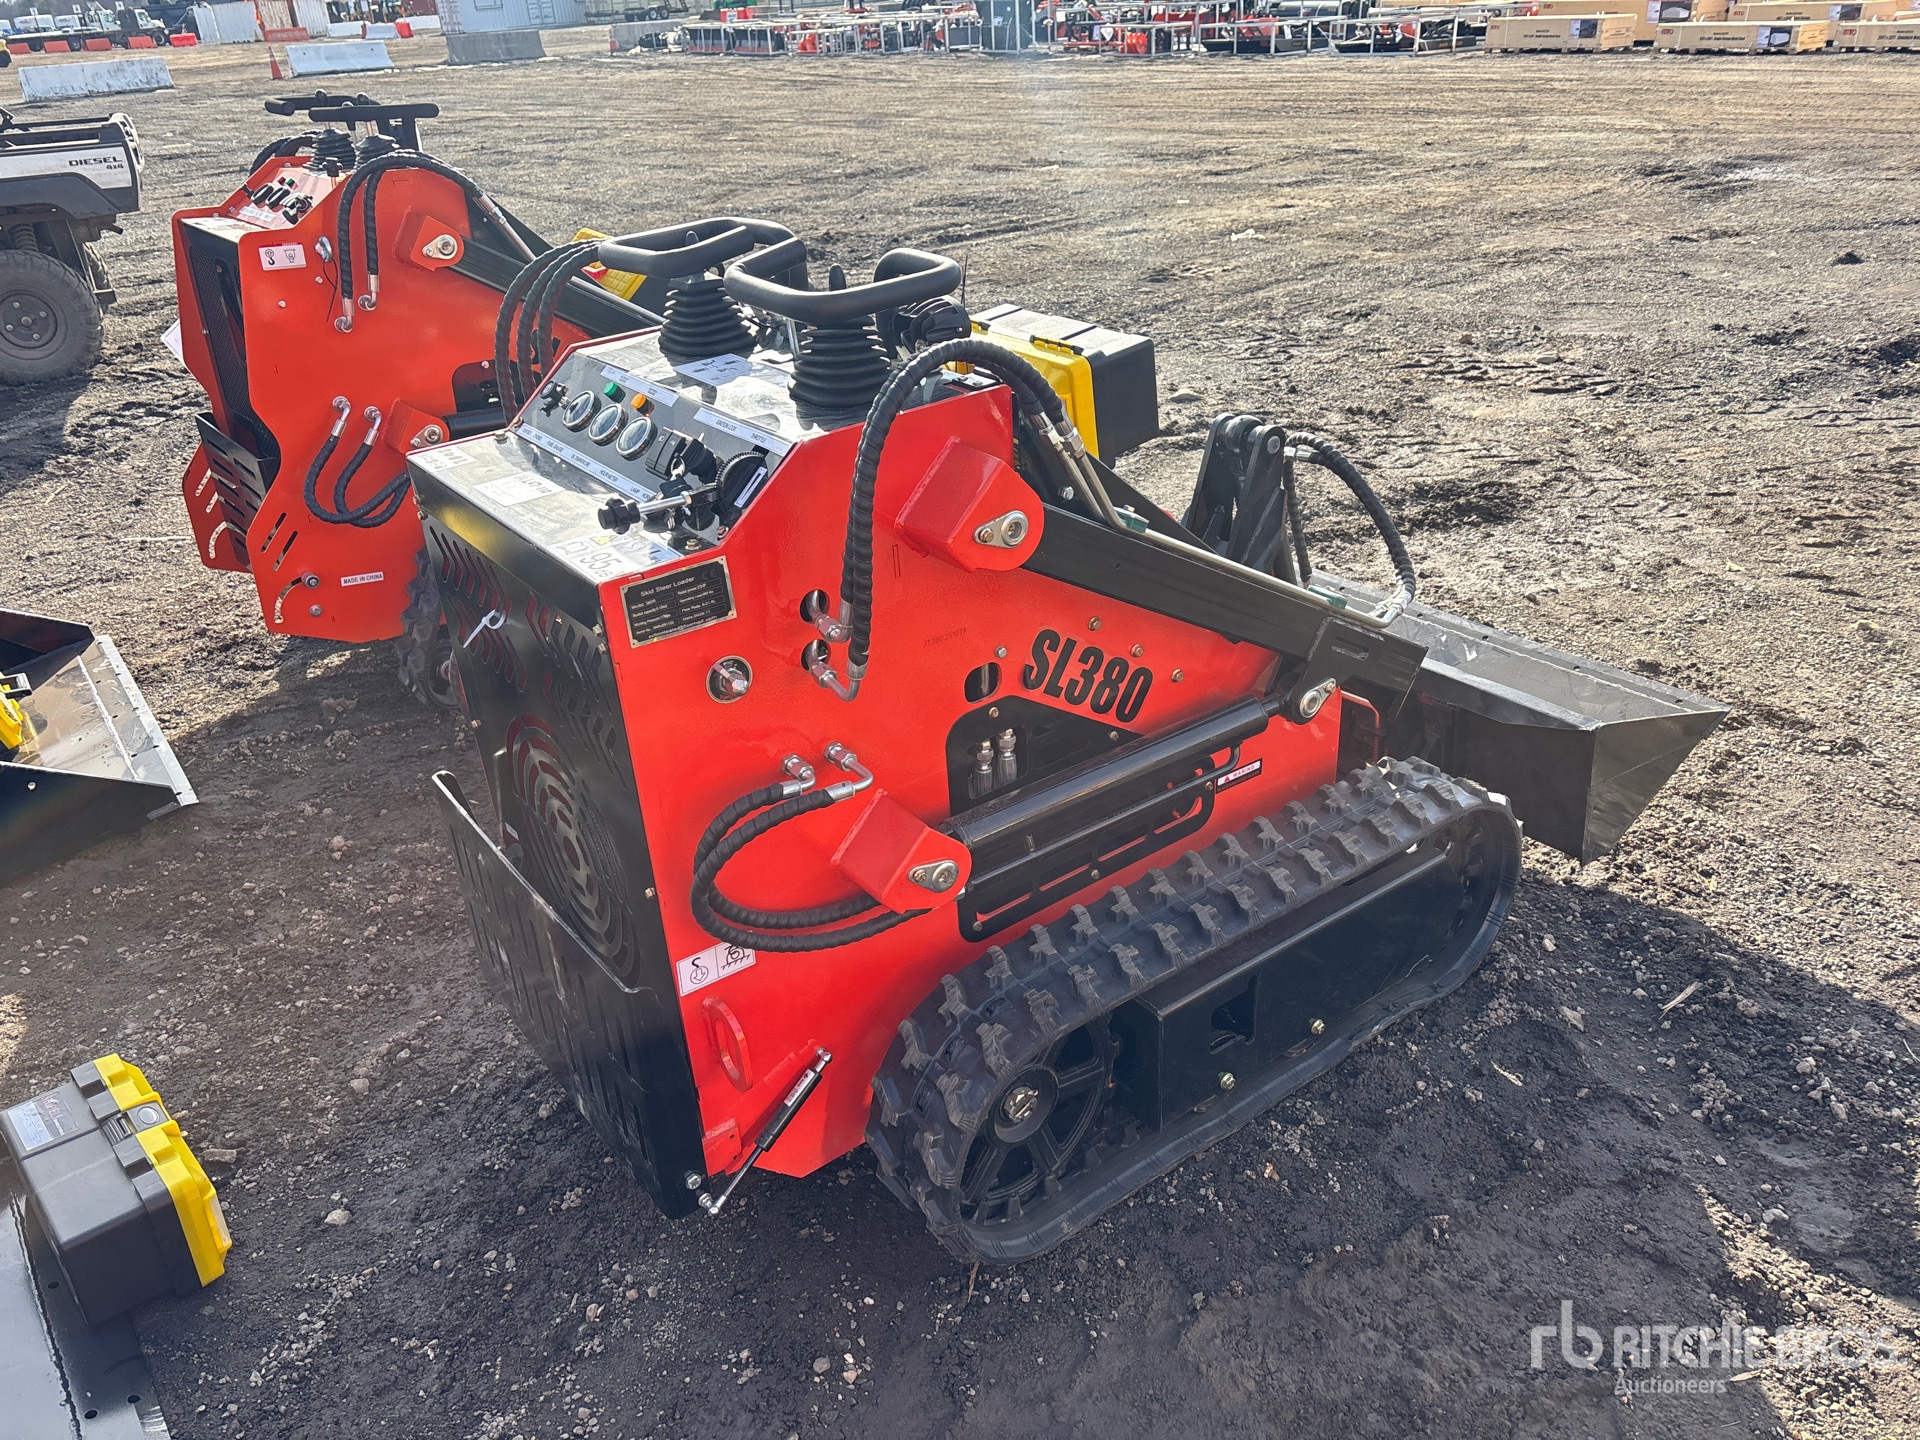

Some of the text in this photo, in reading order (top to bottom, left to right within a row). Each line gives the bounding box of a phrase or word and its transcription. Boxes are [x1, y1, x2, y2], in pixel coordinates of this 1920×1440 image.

[69, 156, 123, 166] DIESEL
[580, 552, 622, 570] 95
[343, 576, 358, 584] MADE
[366, 573, 383, 581] CHINA
[640, 576, 695, 597] Skid Steer Loader
[1022, 629, 1154, 723] SL380
[1233, 765, 1255, 777] WARING
